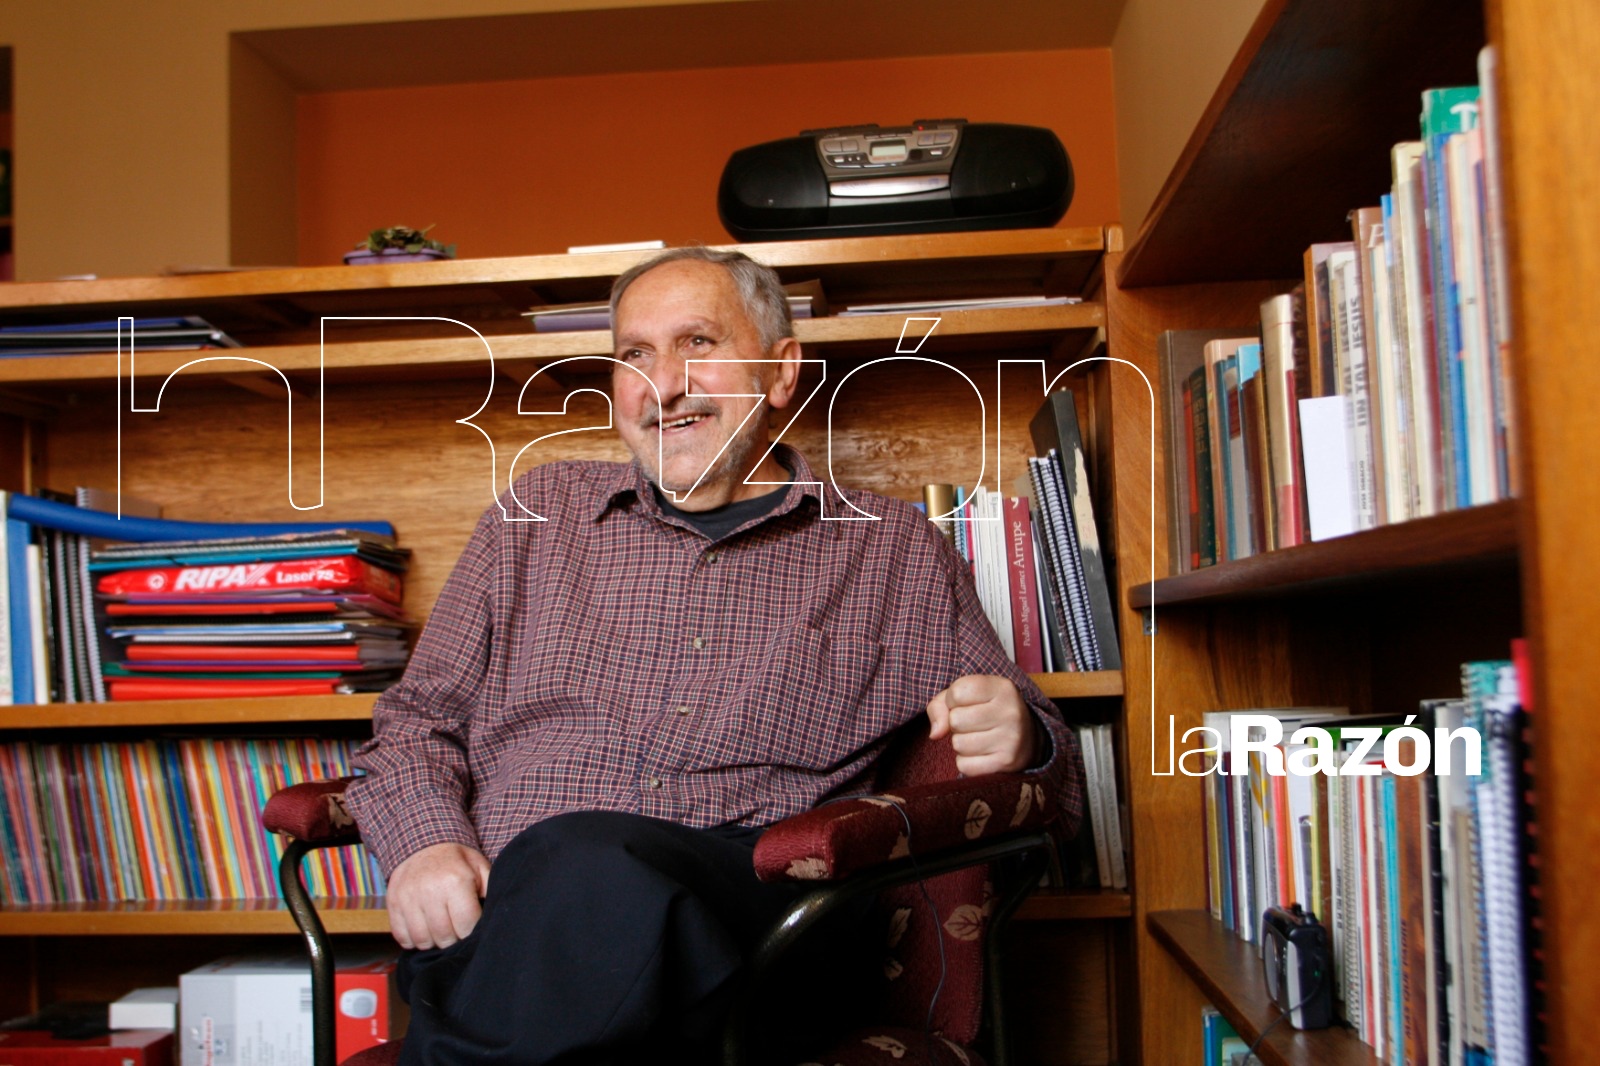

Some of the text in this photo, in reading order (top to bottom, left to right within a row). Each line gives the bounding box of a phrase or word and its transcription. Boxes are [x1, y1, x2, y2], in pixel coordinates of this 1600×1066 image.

[1012, 521, 1026, 568] Arrupe
[173, 563, 280, 591] RIPAX
[276, 570, 316, 584] Laser
[1019, 597, 1030, 622] Miguel
[1022, 623, 1031, 647] Pedro
